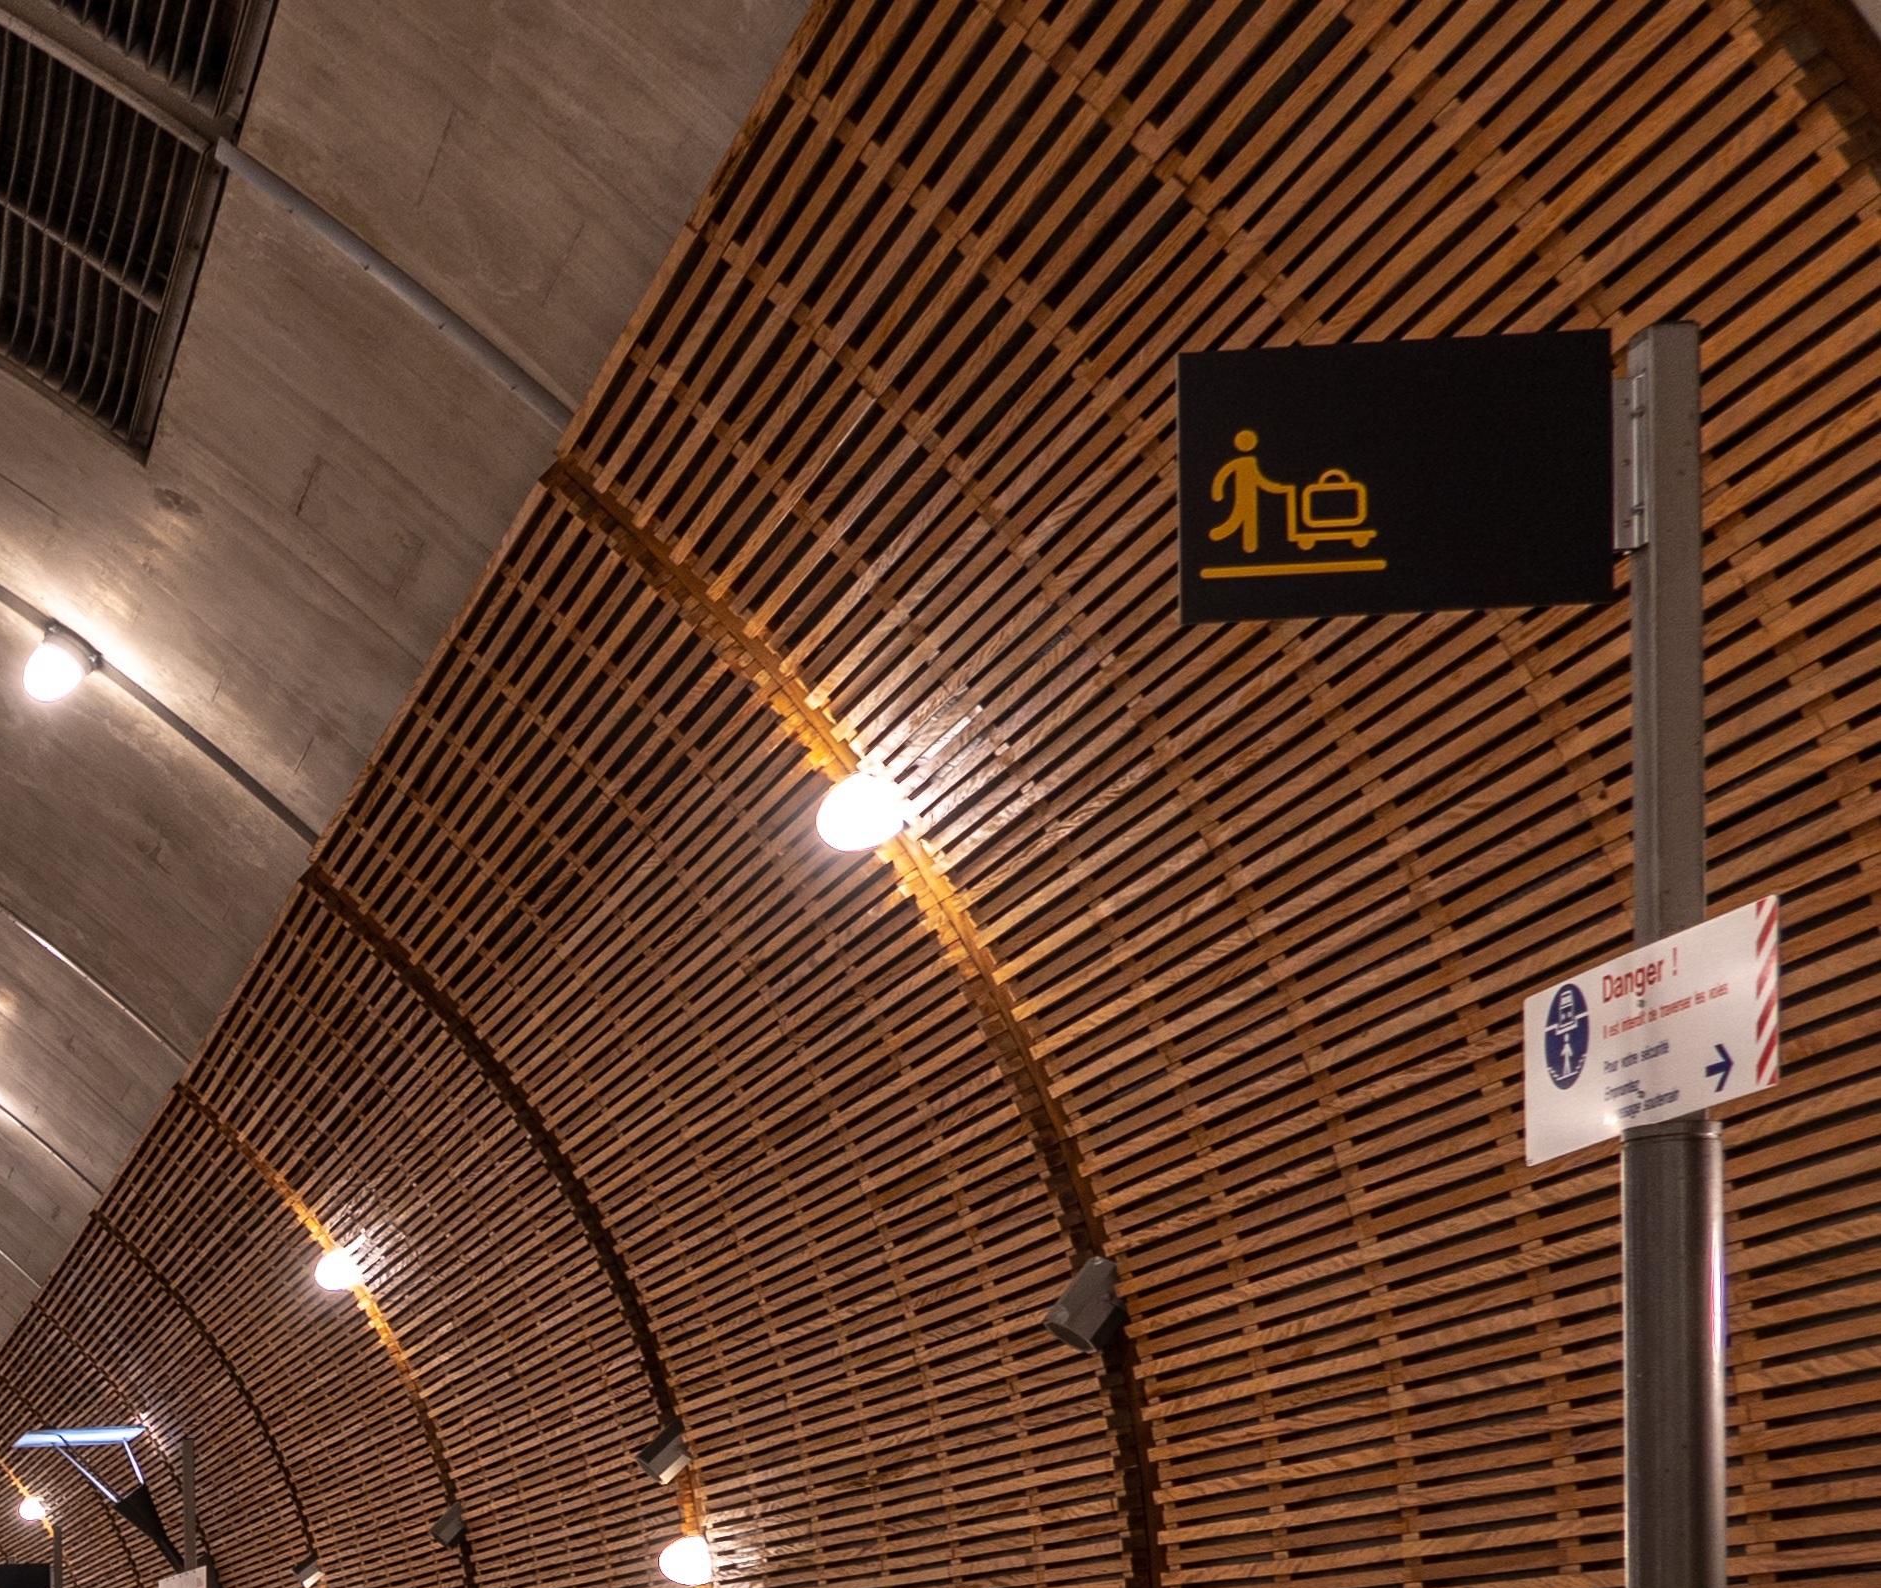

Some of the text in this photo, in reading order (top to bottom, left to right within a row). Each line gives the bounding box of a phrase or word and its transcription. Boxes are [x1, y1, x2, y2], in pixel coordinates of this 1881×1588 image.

[1602, 946, 1678, 1004] Danger !
[1648, 1008, 1658, 1023] de
[1659, 996, 1693, 1019] traverser
